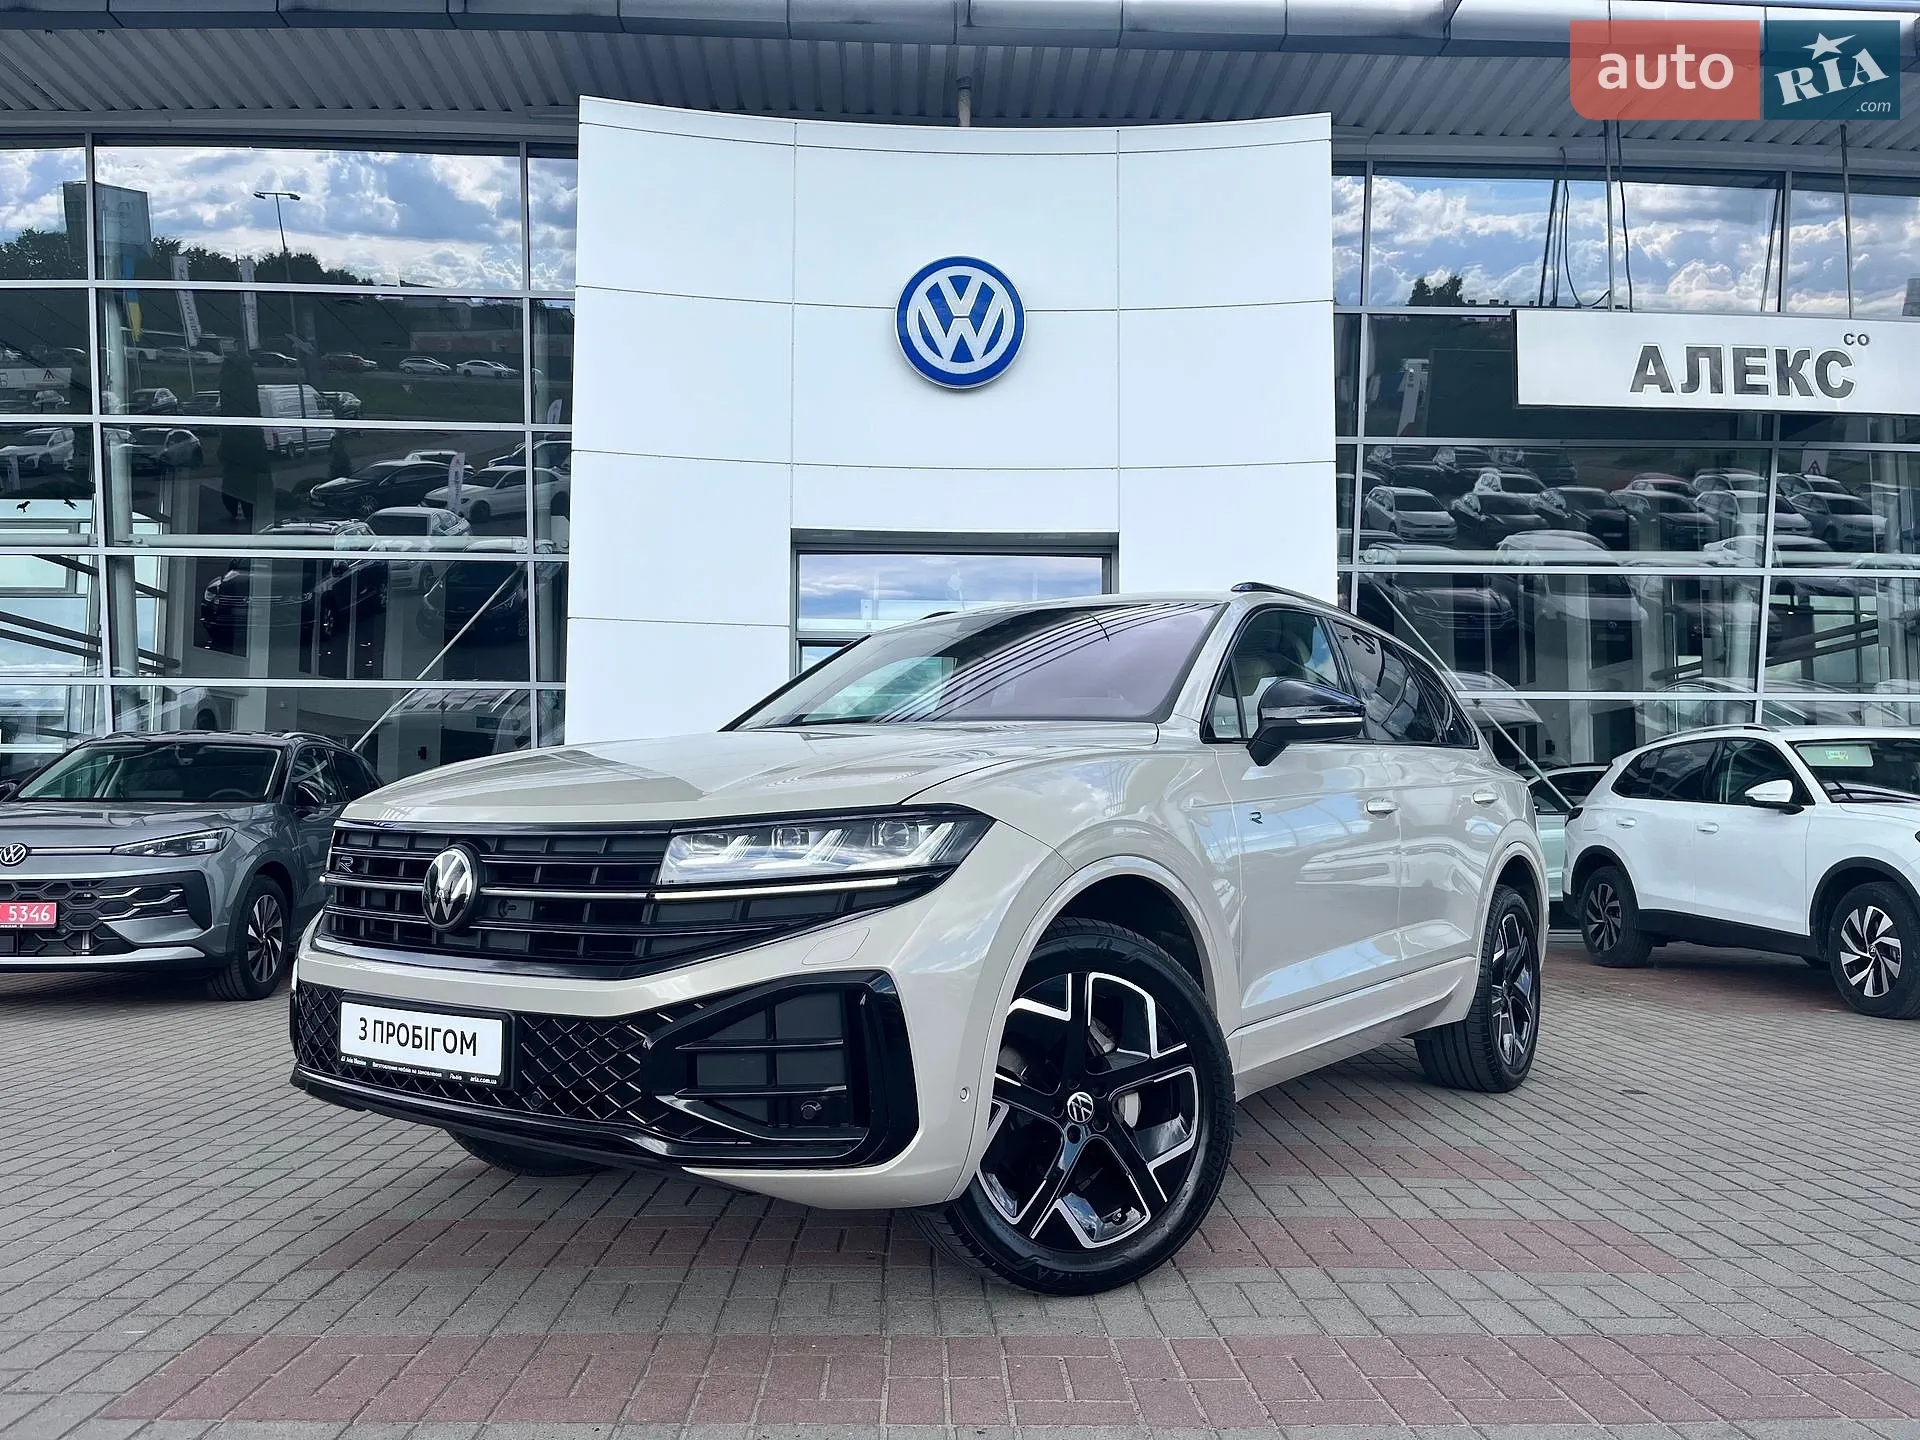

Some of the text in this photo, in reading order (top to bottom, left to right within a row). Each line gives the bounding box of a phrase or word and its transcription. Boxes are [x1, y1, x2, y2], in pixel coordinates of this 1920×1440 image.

[1629, 343, 1857, 400] АЛЕКС
[8, 905, 51, 922] 5346
[372, 1019, 477, 1057] ПРОБІГОМ
